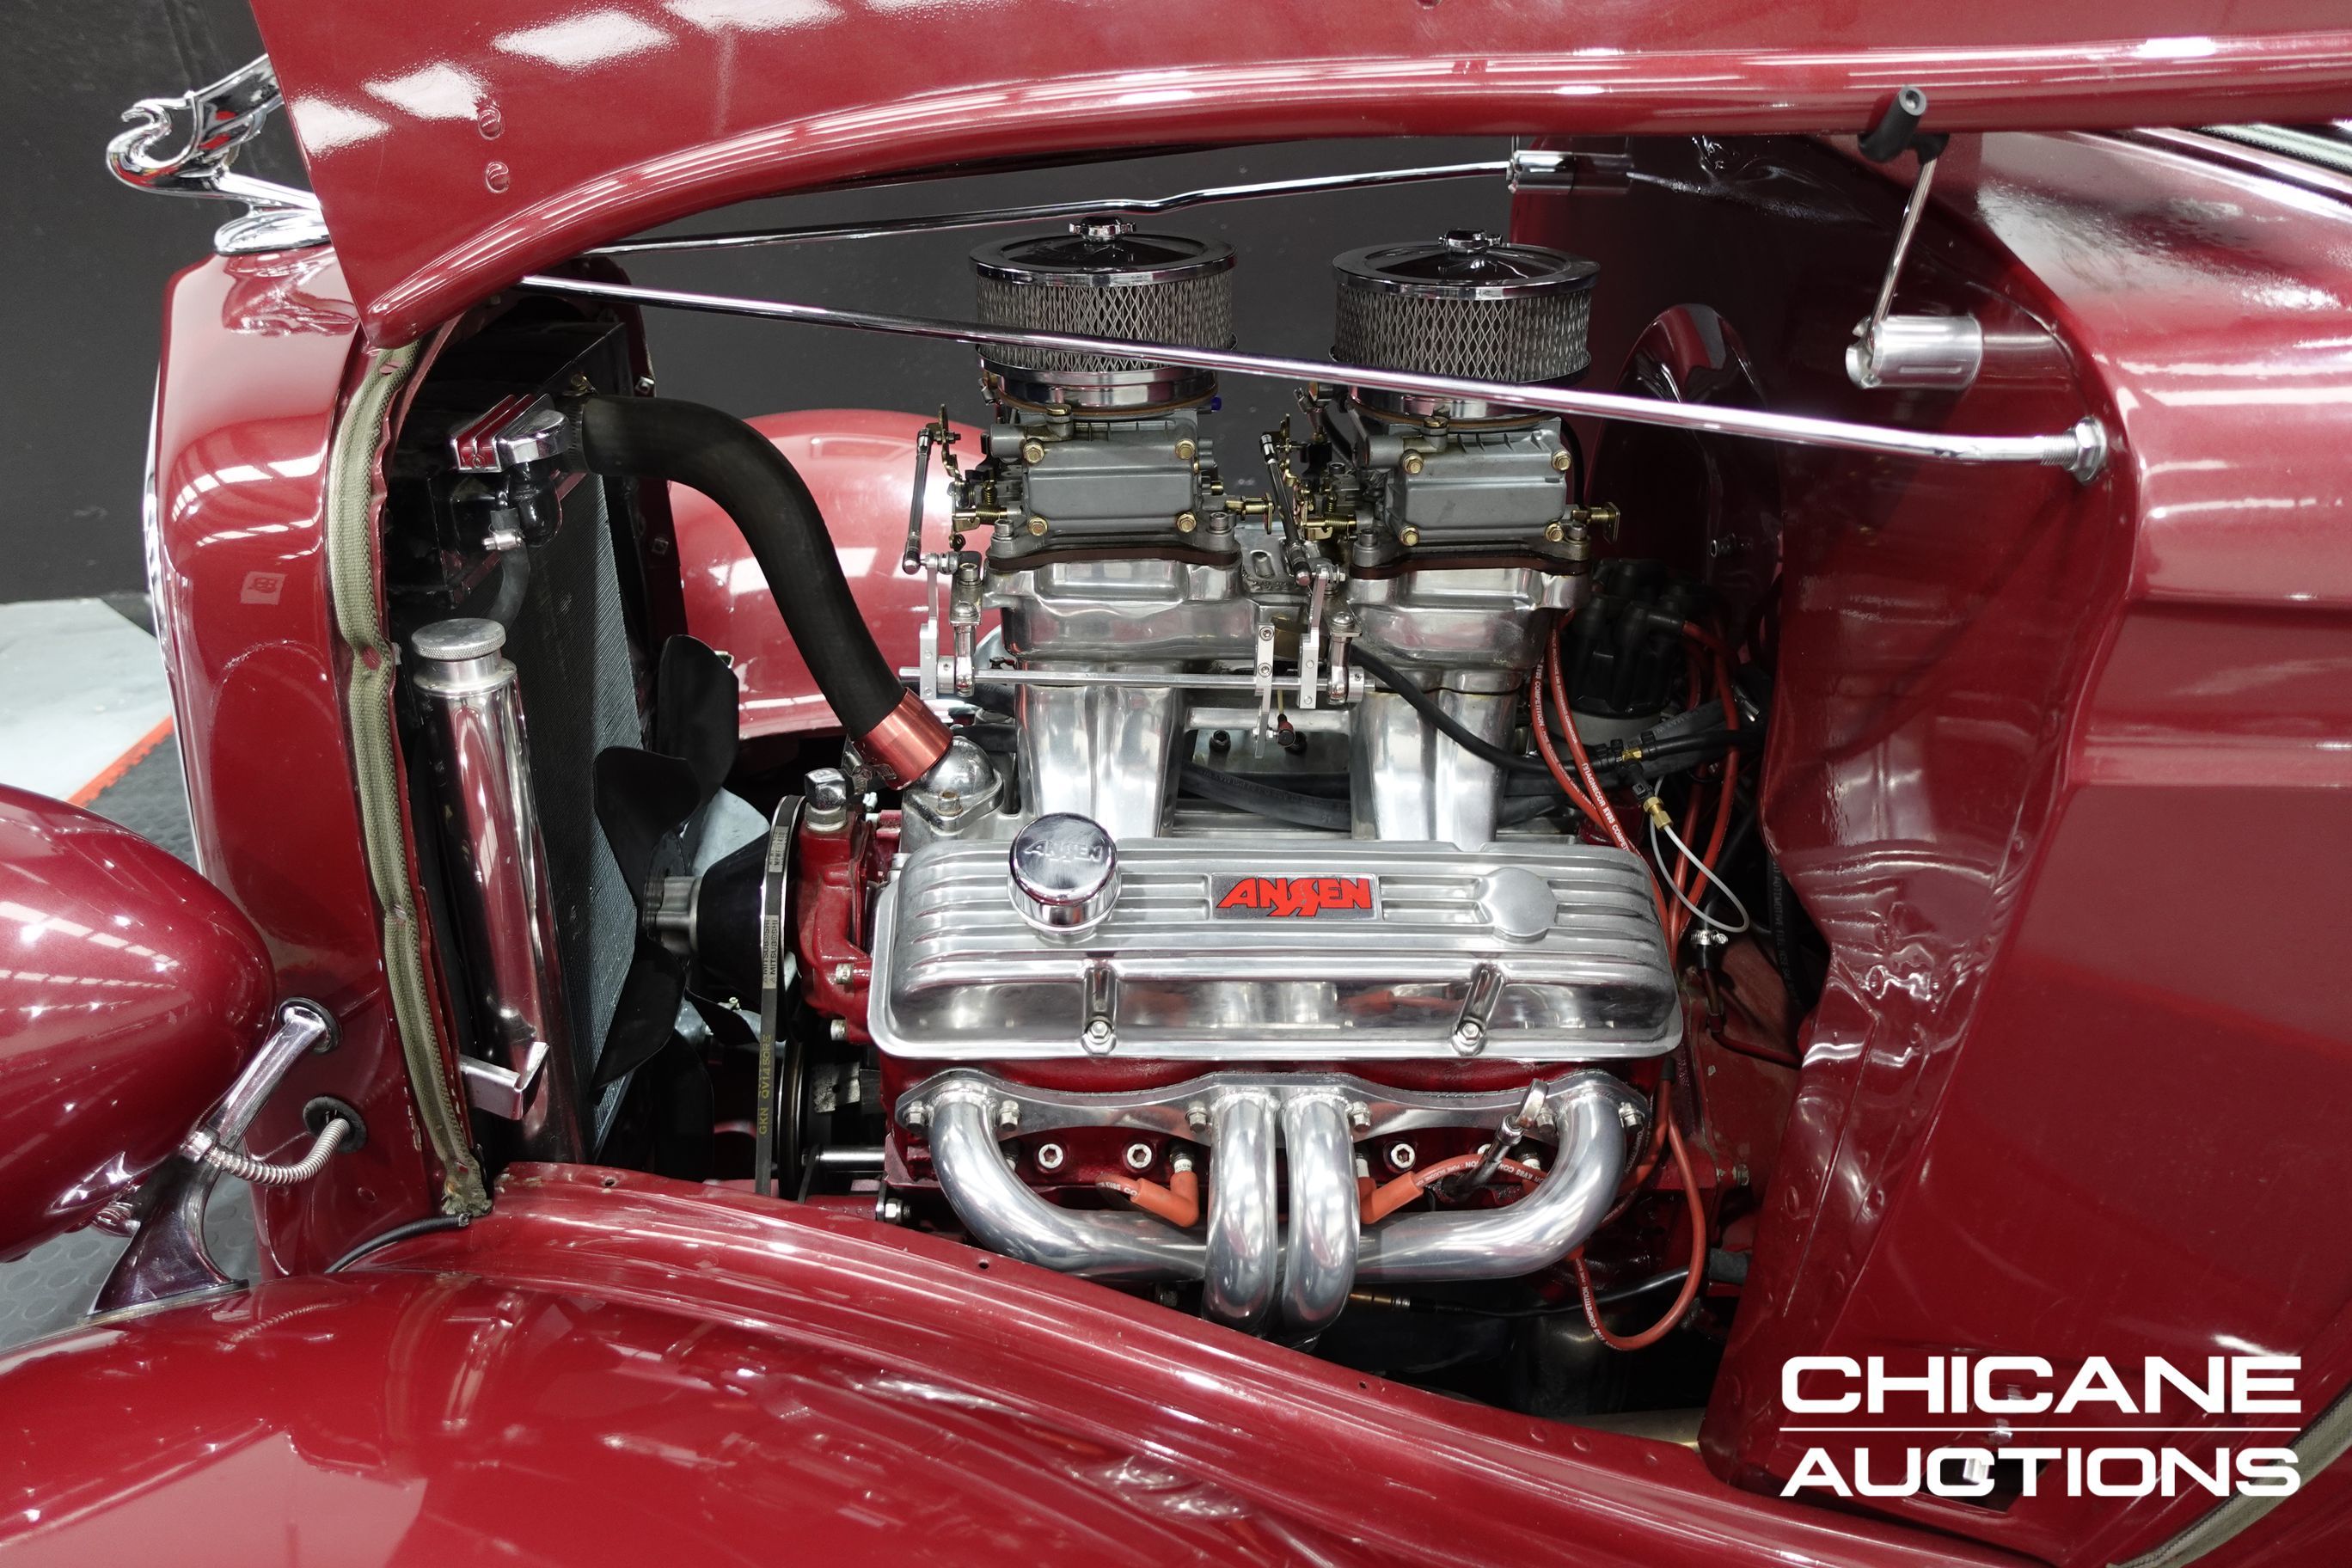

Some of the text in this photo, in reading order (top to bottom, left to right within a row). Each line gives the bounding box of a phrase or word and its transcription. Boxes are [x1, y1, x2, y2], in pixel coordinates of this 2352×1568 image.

[1534, 681, 1545, 726] COMPETITION
[1581, 763, 1607, 806] MAGNECOR
[1602, 806, 1616, 824] KV85
[769, 920, 778, 975] MITSUBOSHI
[758, 1107, 769, 1135] GKN
[1581, 1286, 1597, 1327] COMPETITION
